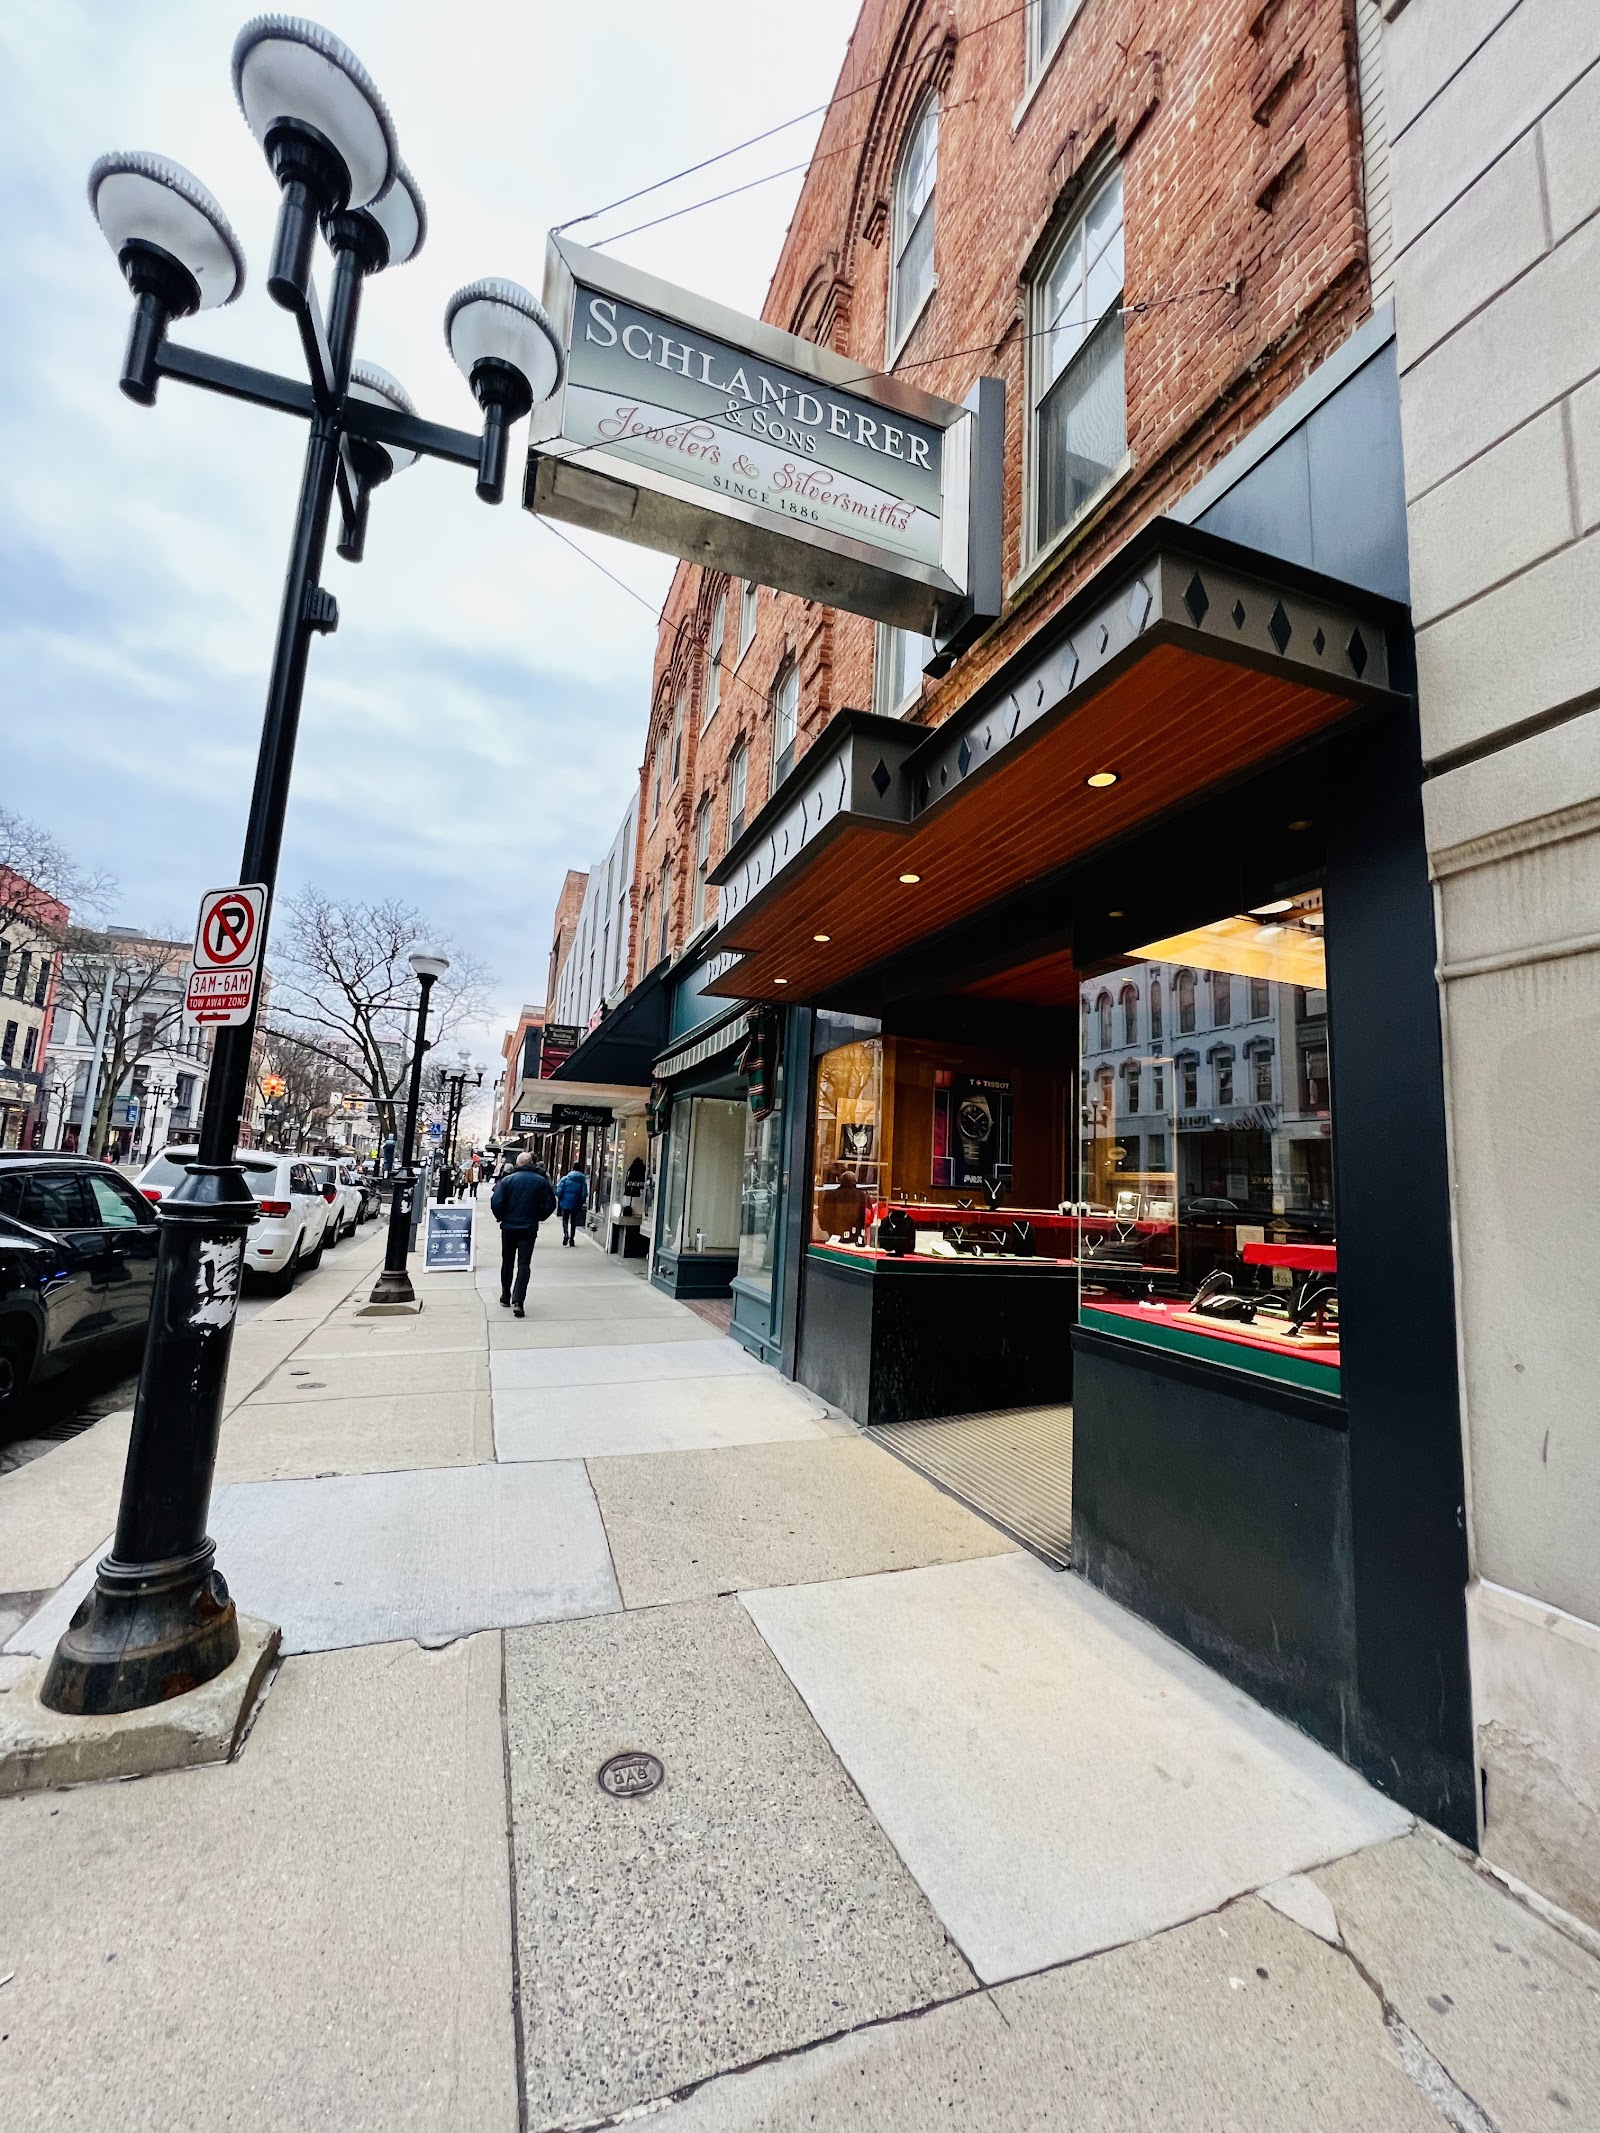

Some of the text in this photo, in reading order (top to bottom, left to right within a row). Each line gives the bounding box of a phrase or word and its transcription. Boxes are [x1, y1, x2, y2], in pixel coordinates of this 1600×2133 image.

[584, 297, 933, 472] SCHLANDERER
[725, 399, 817, 454] & SONS
[597, 406, 917, 532] Jewelers & Silversmiths
[713, 474, 820, 521] SINCE 1886
[193, 974, 248, 994] 3AM-6AM
[189, 996, 247, 1008] TOW AWAY ZONE
[983, 1080, 1010, 1090] TISSOT
[963, 1174, 983, 1184] PRX
